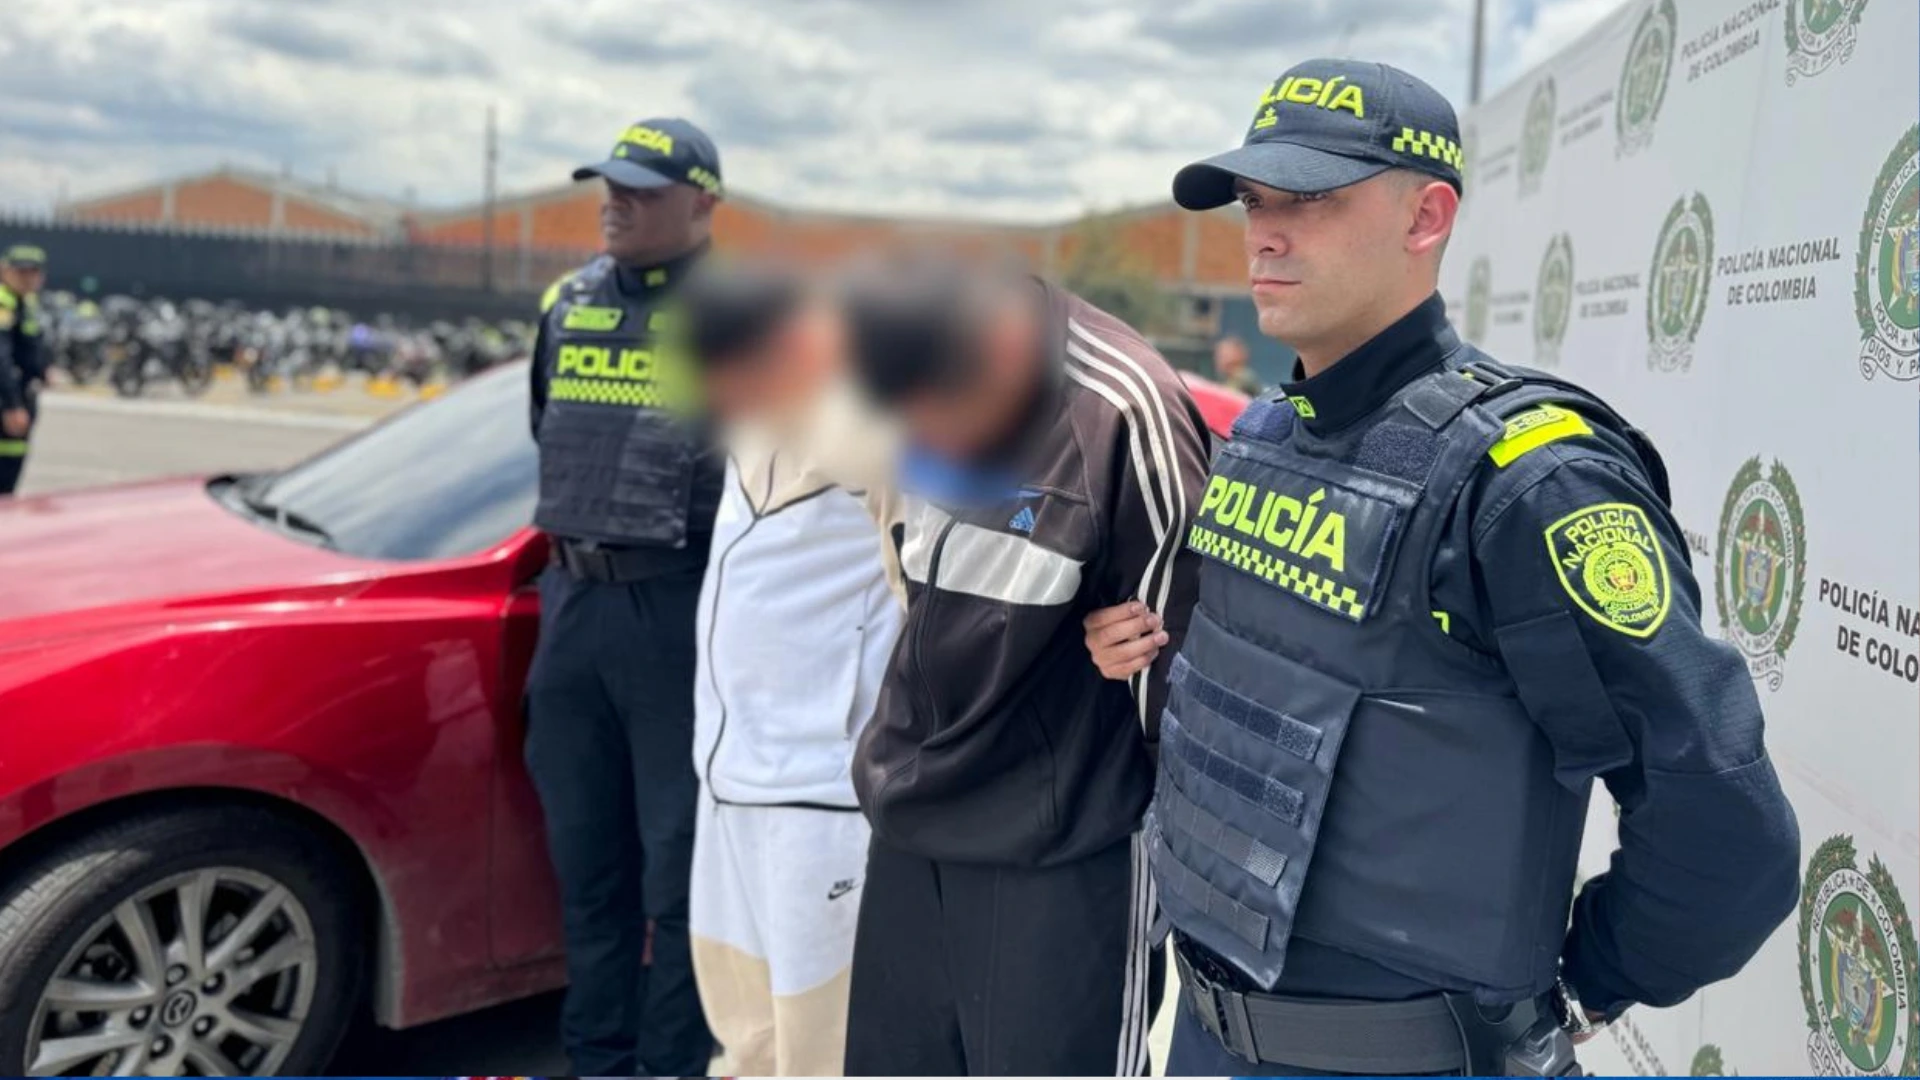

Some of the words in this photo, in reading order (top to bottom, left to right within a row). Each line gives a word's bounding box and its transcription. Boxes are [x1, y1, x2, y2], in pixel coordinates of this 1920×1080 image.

[1717, 245, 1764, 276] POLICÍA
[1766, 237, 1841, 268] NACIONAL
[1728, 285, 1743, 305] DE
[1746, 276, 1816, 304] COLOMBIA
[1868, 339, 1891, 368] DIOS
[1199, 475, 1345, 572] POLICÍA
[1562, 528, 1653, 569] NACIONAL
[1819, 578, 1889, 628] POLICÍA
[1837, 624, 1860, 658] DE
[1865, 637, 1919, 683] COLO
[1855, 876, 1870, 900] DE
[1876, 904, 1907, 1010] COLOMBIA
